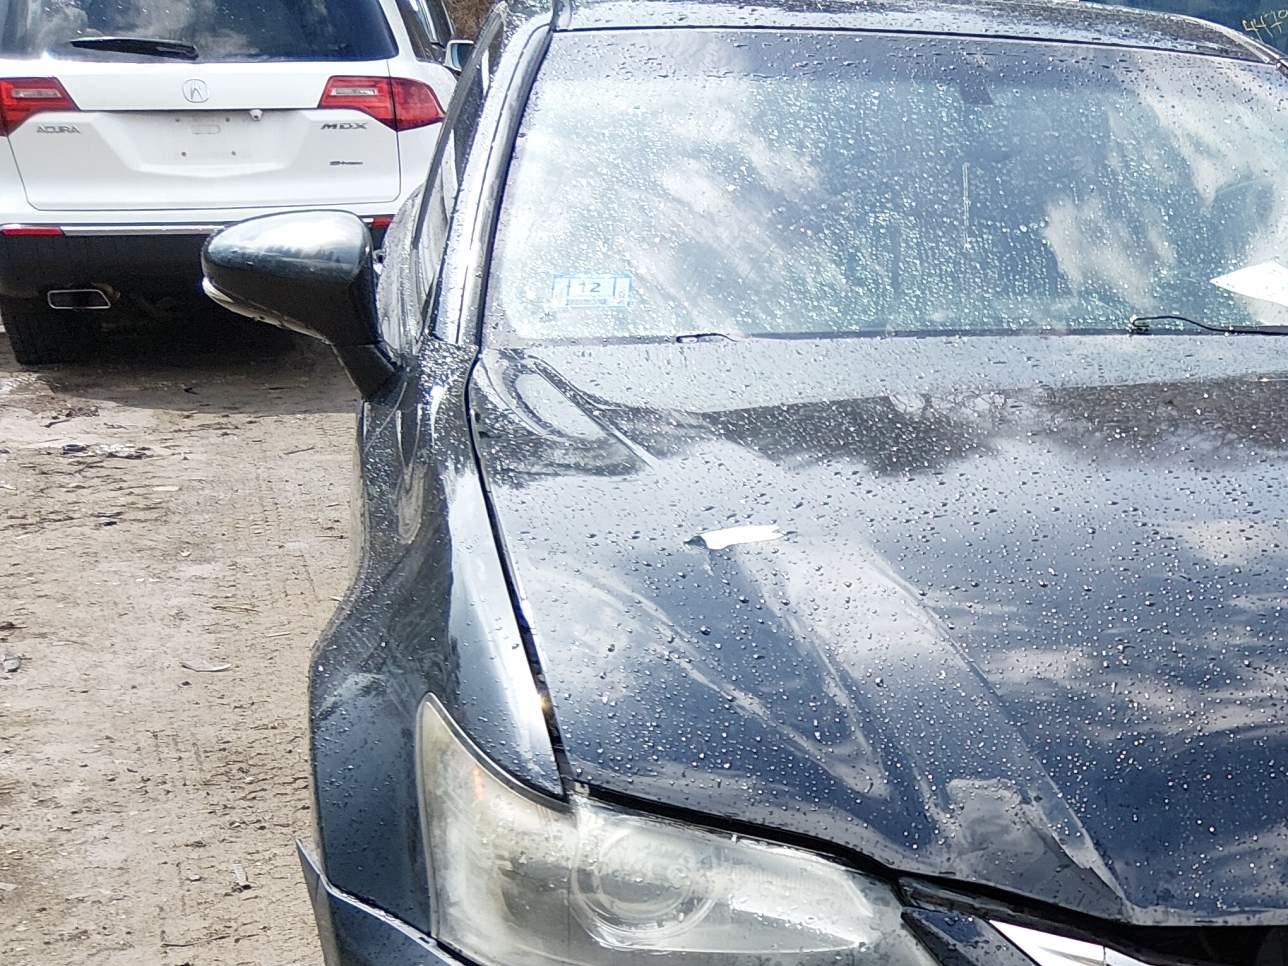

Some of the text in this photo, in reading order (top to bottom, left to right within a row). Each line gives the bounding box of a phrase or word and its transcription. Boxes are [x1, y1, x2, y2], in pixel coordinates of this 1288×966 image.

[37, 124, 81, 135] ACURA
[320, 122, 368, 130] MDX
[577, 281, 602, 294] 12
